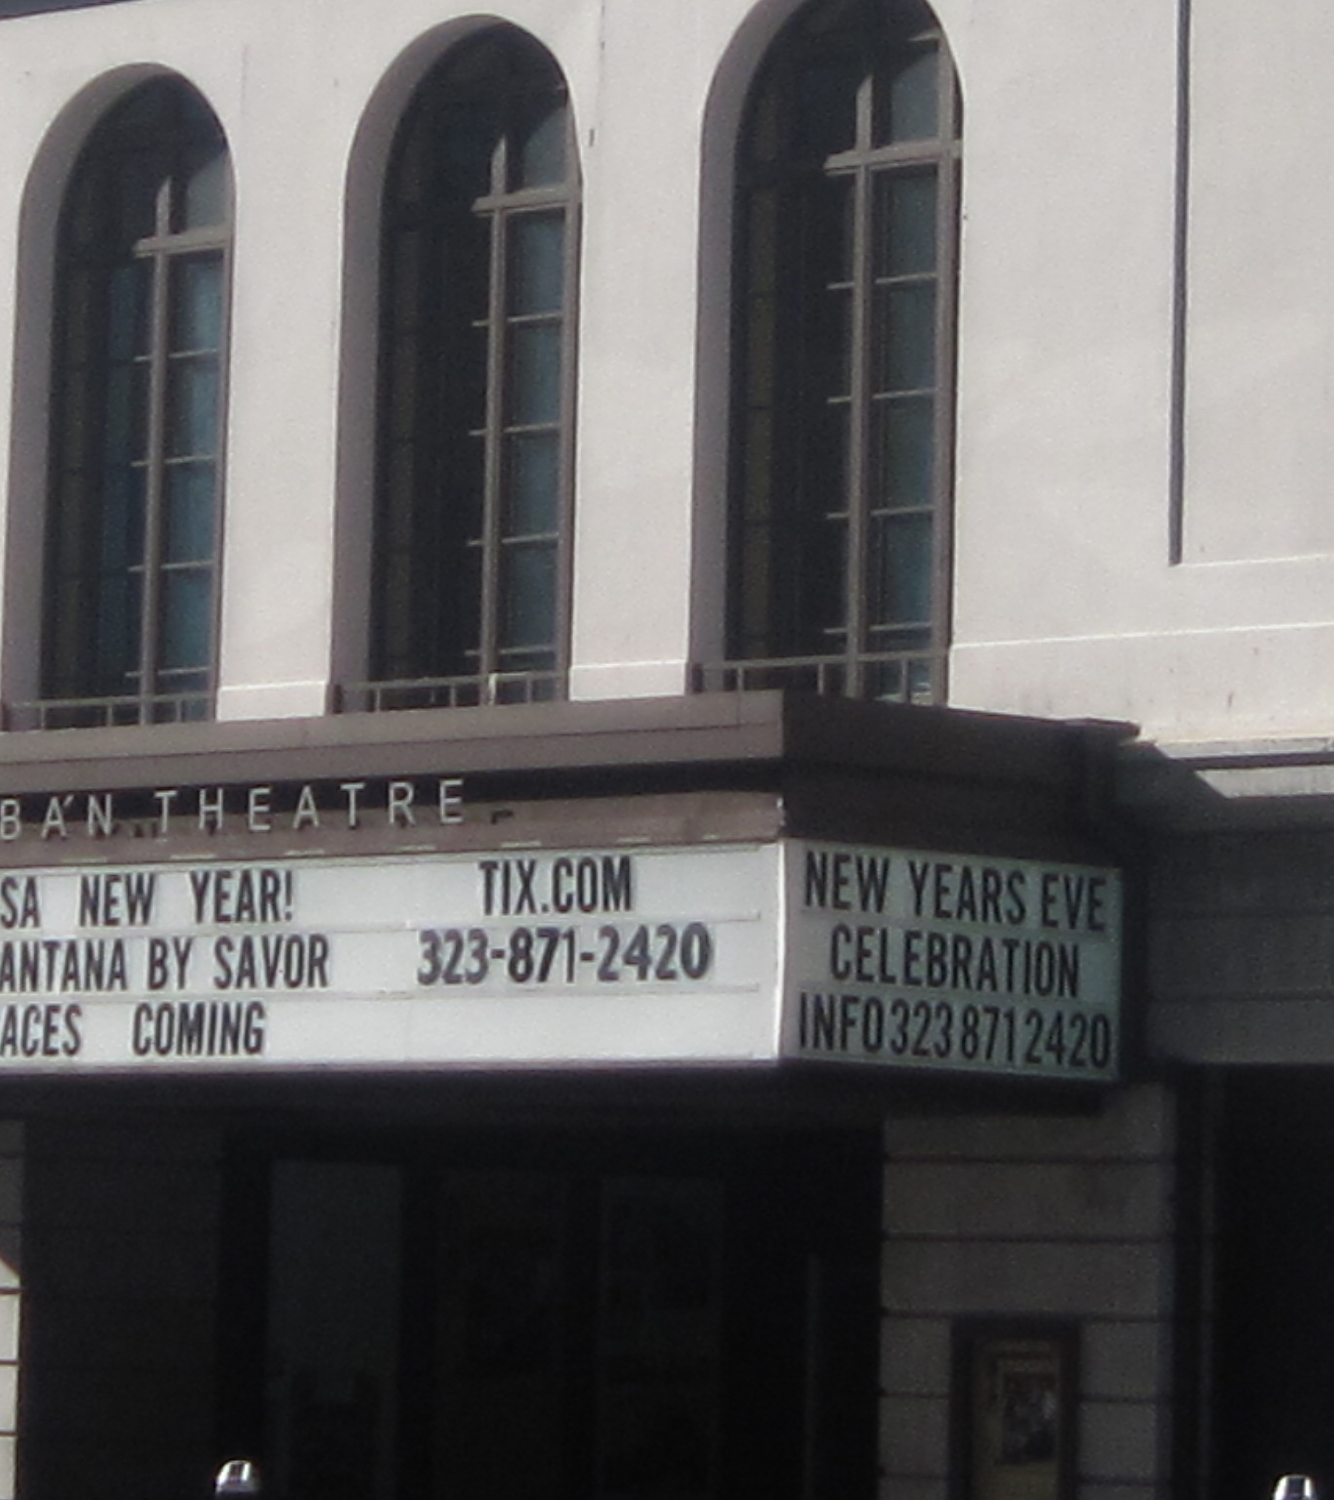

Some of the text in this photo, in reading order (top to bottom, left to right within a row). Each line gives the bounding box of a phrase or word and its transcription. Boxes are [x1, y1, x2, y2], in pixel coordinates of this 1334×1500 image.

[154, 779, 463, 832] THEATRE
[78, 872, 155, 927] NEW
[189, 868, 294, 923] YEAR!
[478, 855, 634, 917] TIX.COM
[804, 850, 1107, 932] NEW YEARS EVE
[147, 937, 192, 991] BY
[212, 934, 330, 991] SAVOR
[416, 922, 715, 987] 323-871-2420
[830, 924, 1080, 998] CELEBRATION
[131, 1002, 267, 1058] COMING
